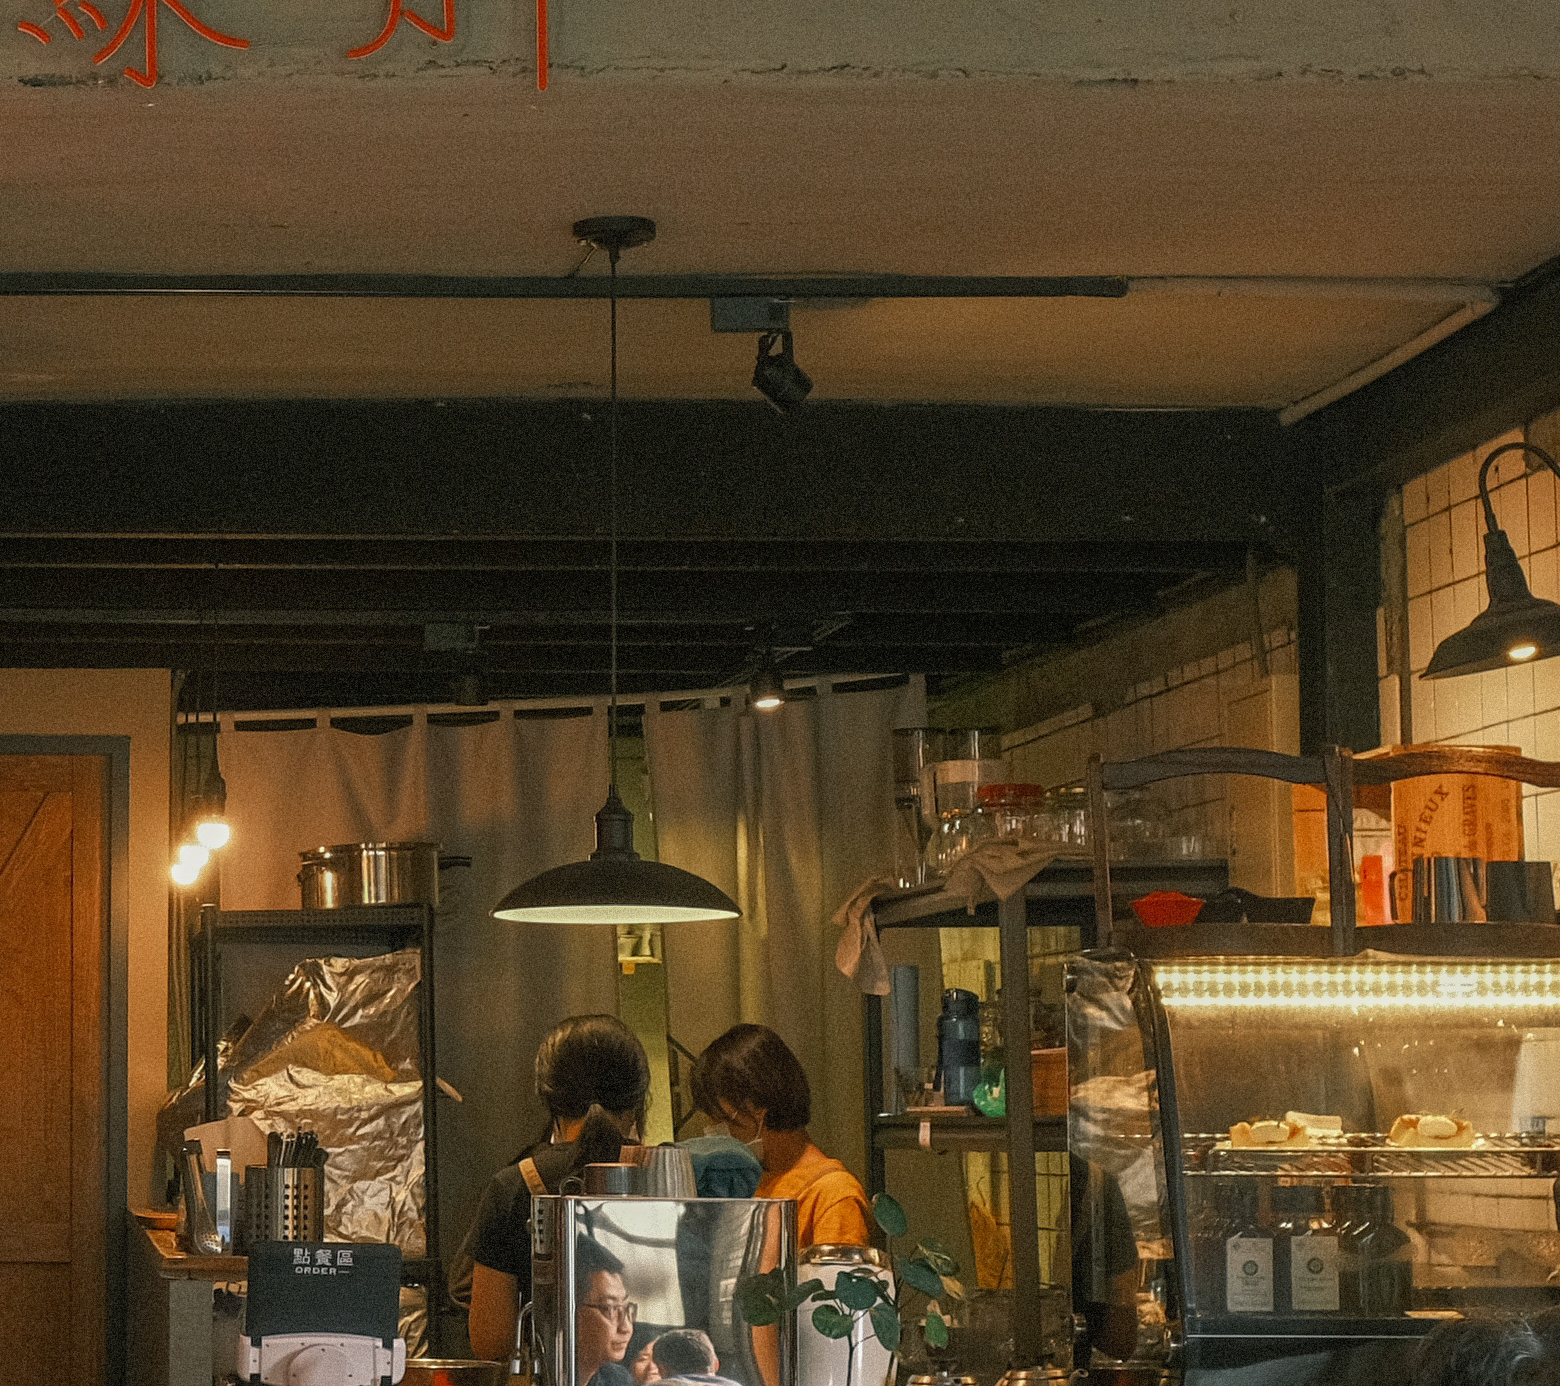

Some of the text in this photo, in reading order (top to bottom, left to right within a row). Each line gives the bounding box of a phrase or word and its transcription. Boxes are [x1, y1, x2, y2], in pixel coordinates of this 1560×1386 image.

[292, 1247, 355, 1267] 點餐區
[294, 1266, 338, 1276] ORDER
